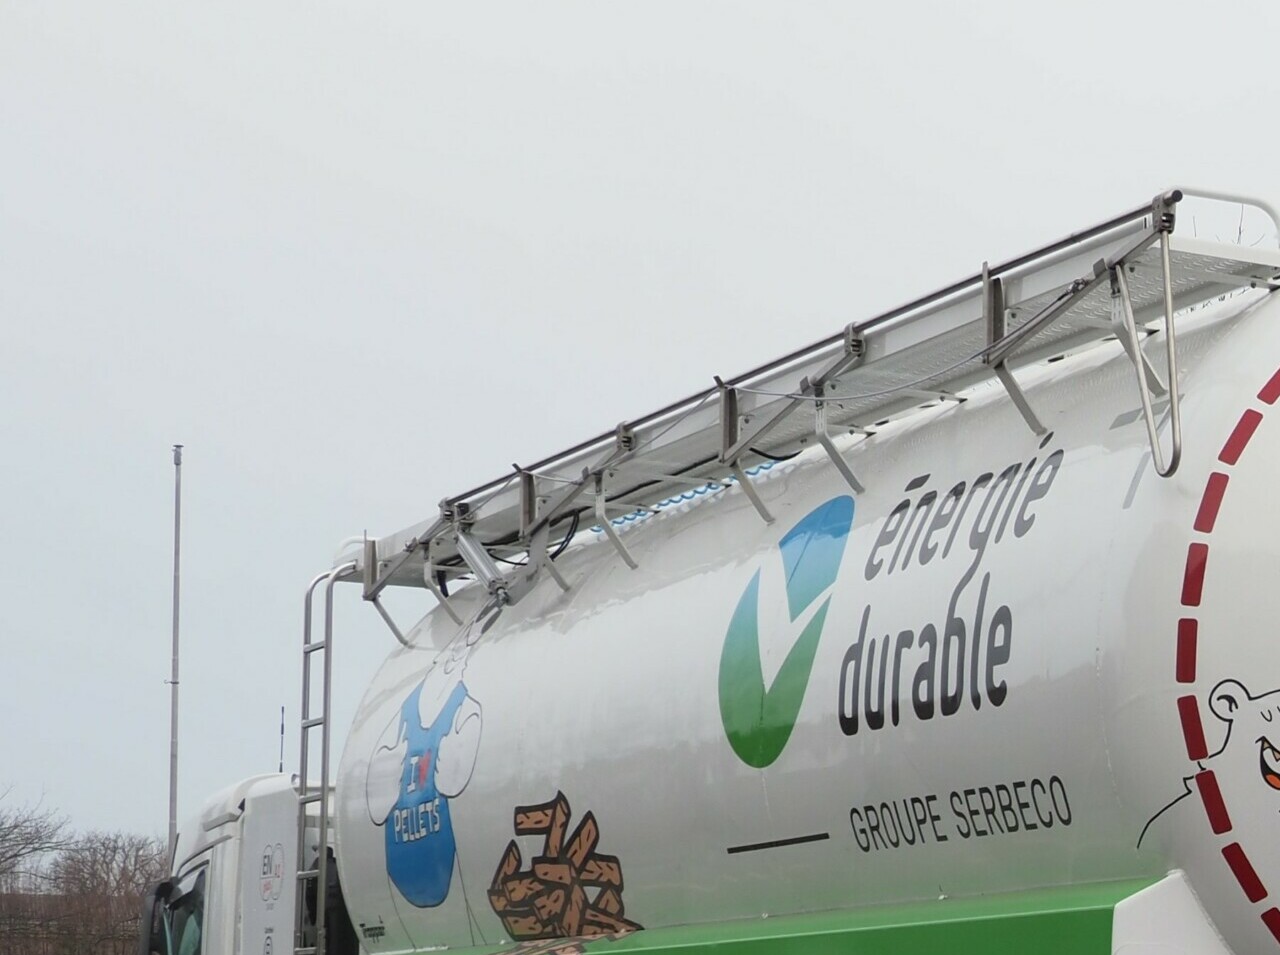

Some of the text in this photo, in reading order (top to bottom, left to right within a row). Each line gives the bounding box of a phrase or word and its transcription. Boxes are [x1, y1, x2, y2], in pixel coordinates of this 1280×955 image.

[864, 431, 1064, 594] énergie
[838, 572, 1013, 737] durable
[407, 755, 419, 793] I
[393, 798, 440, 843] PELLETS
[849, 775, 1072, 853] GROUPE SERBECO
